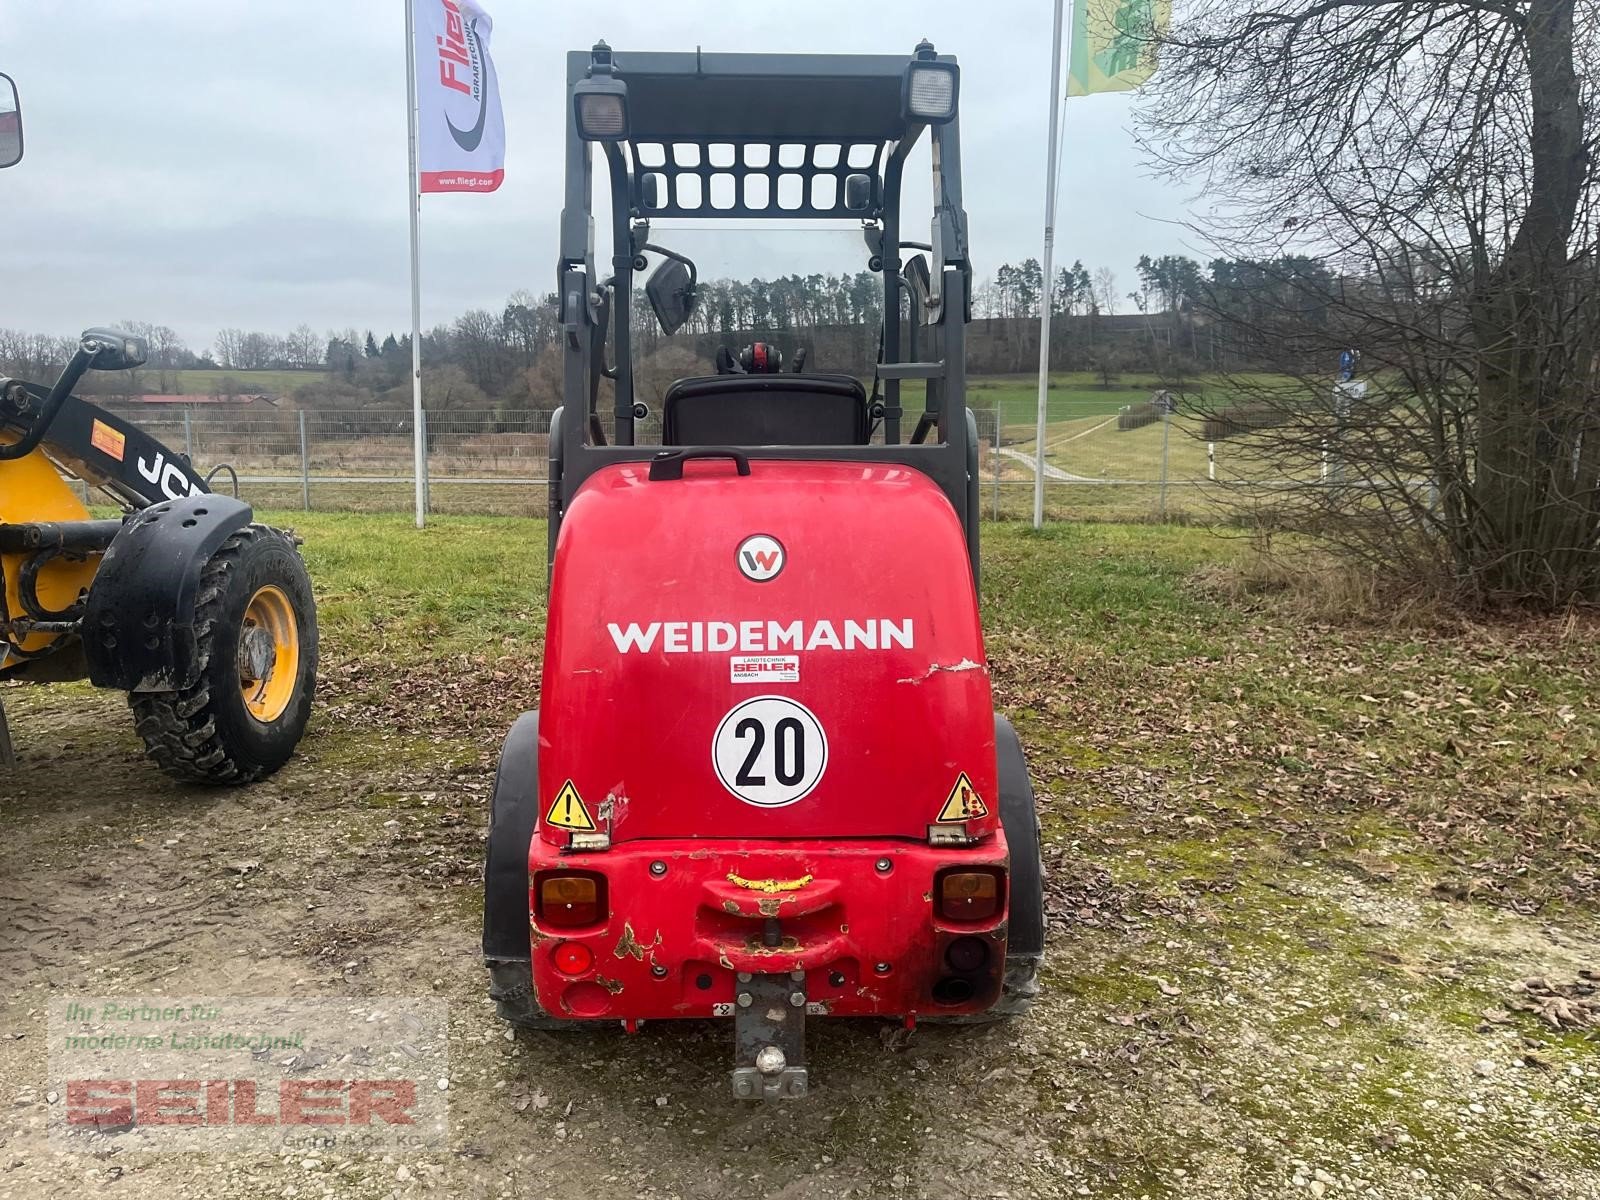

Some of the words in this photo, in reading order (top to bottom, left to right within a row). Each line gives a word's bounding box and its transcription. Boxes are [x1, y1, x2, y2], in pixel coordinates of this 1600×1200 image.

[607, 618, 914, 653] WEIDEMANN
[733, 663, 796, 672] SEILER
[735, 717, 805, 787] 20
